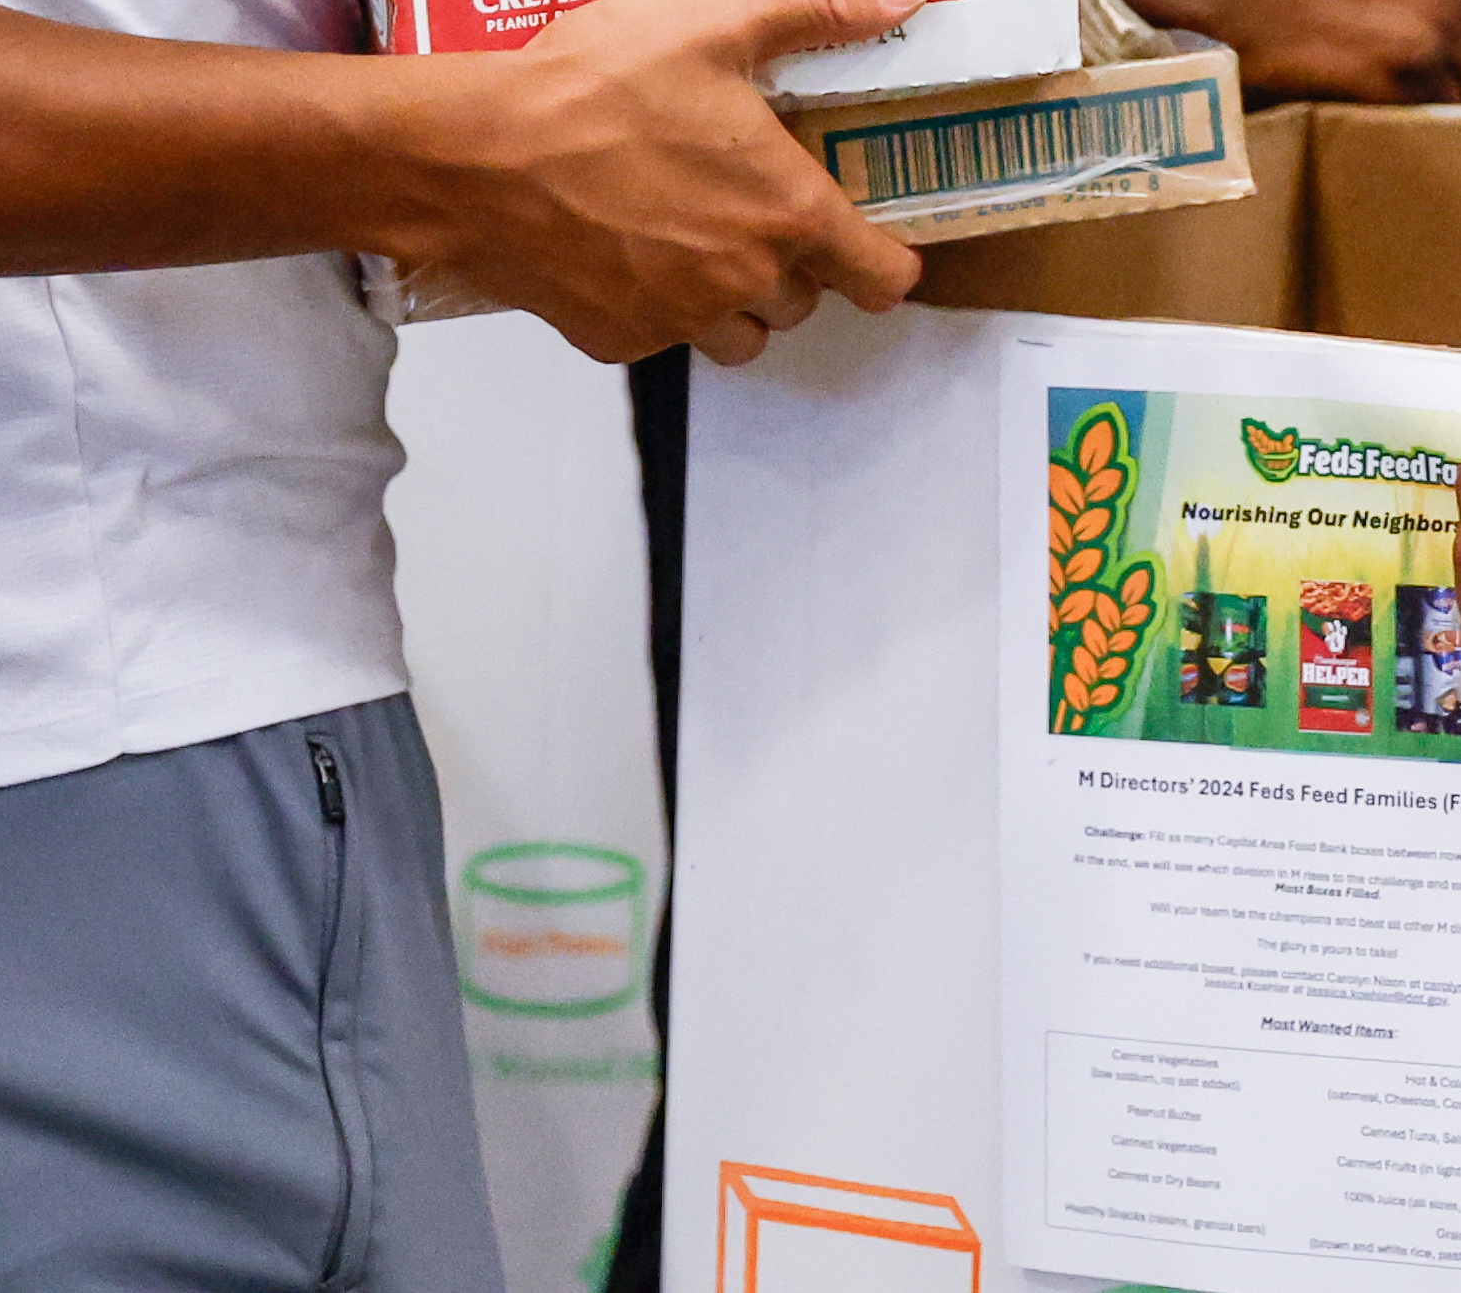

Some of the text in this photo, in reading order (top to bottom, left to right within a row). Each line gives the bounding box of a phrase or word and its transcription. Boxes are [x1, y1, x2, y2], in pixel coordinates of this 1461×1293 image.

[486, 11, 550, 33] PEANUT
[1181, 501, 1301, 528] Nourishing
[1307, 507, 1346, 527] Our
[1301, 662, 1370, 686] HELPER
[1079, 771, 1094, 786] M
[1199, 779, 1243, 797] 2024
[1250, 782, 1294, 800] Feds
[1301, 785, 1347, 803] Feed
[1354, 789, 1437, 809] Families
[1299, 1020, 1352, 1036] Wanted
